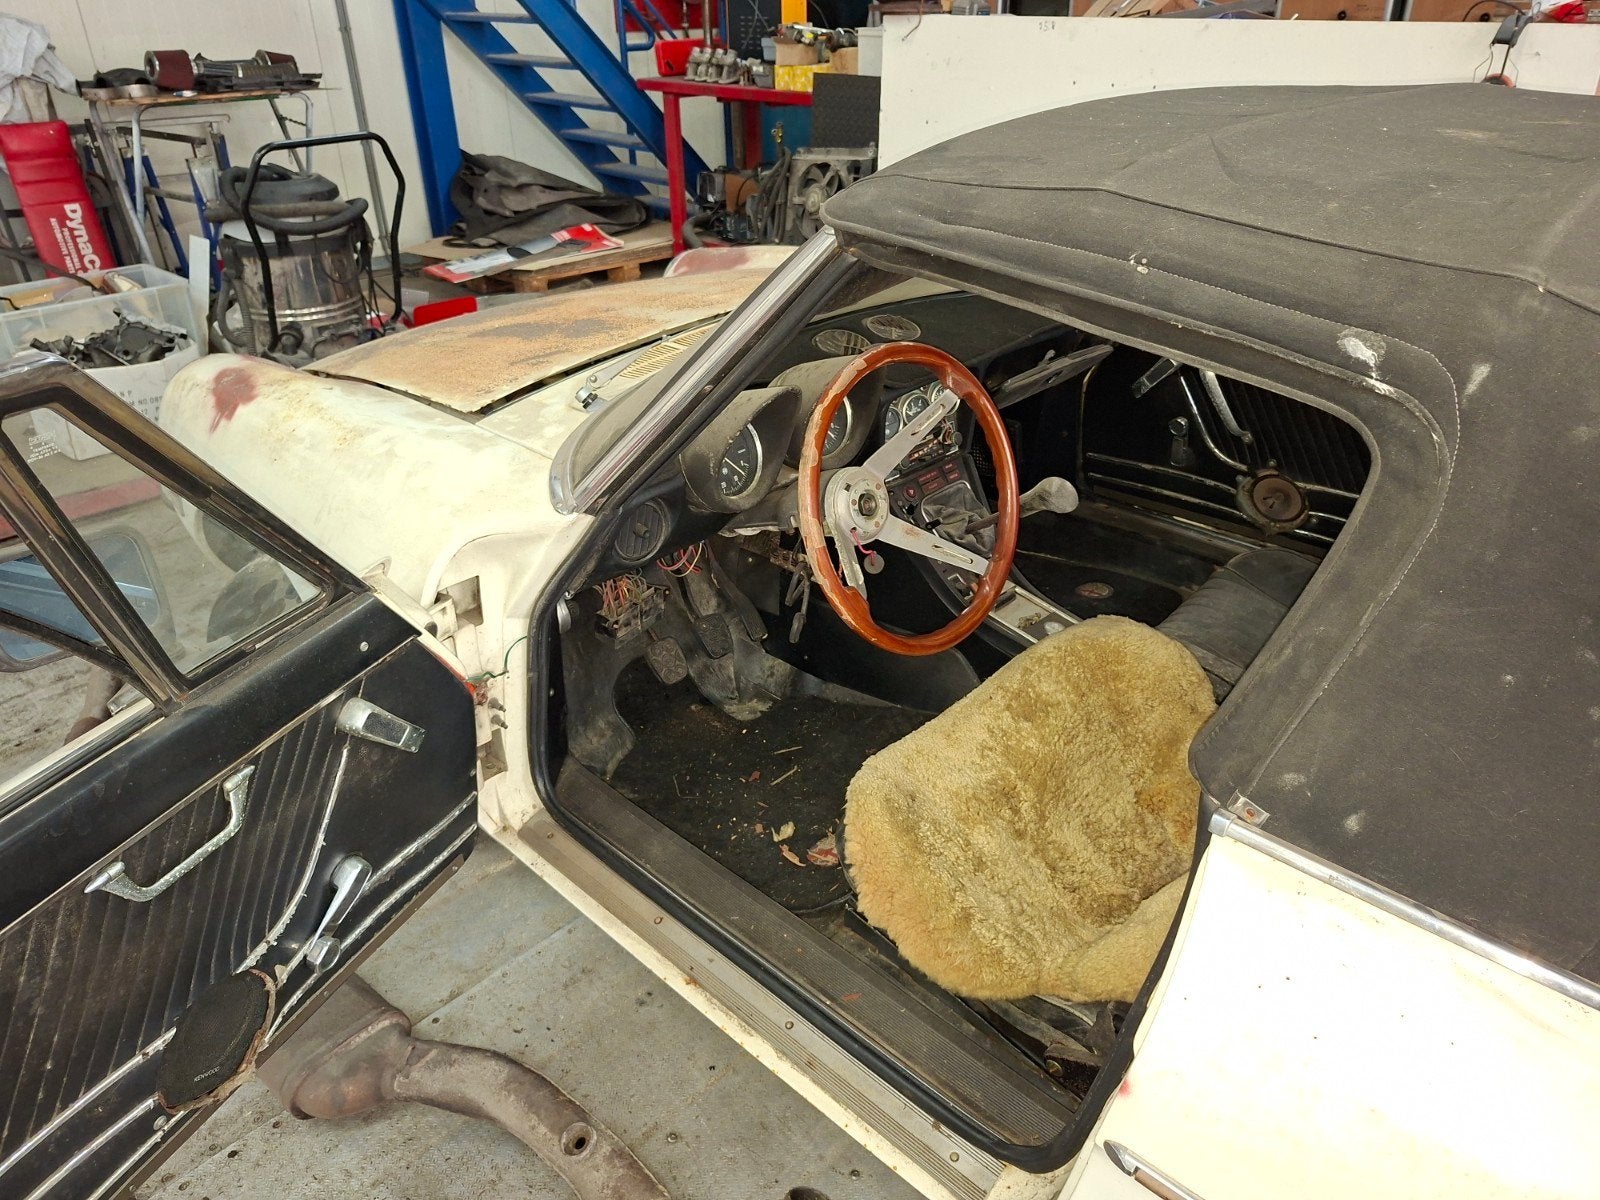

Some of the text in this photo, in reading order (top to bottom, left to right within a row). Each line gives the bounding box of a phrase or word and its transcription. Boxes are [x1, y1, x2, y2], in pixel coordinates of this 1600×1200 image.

[49, 217, 76, 274] AUTOMOTIVE PARTS
[62, 227, 82, 270] PROFESSIONAL
[193, 1066, 220, 1082] KENWOOD
